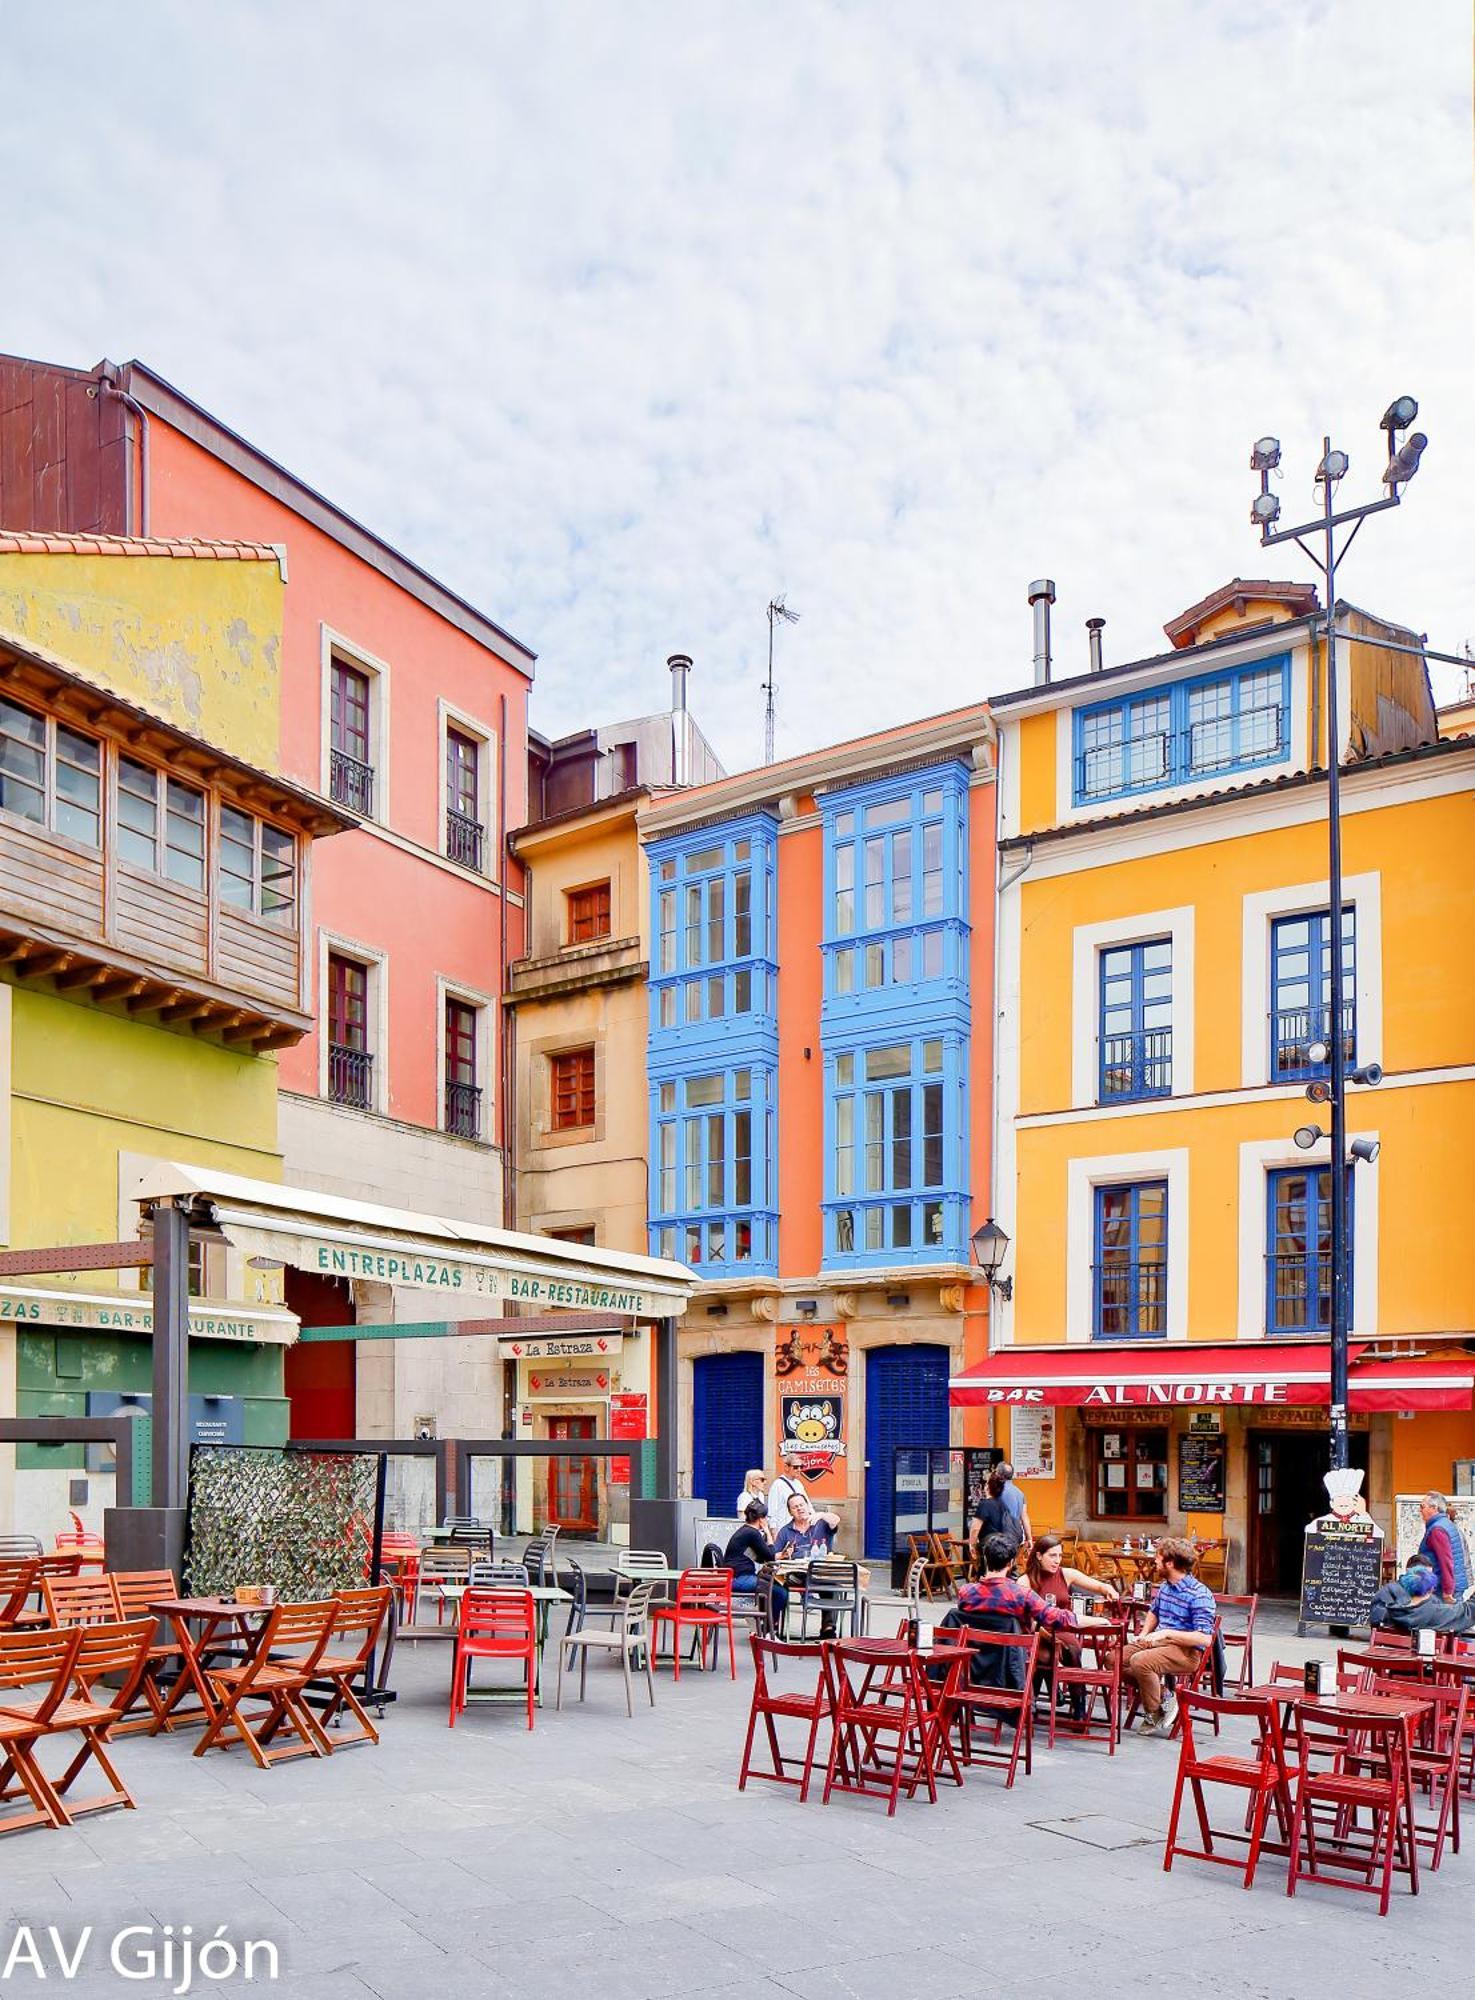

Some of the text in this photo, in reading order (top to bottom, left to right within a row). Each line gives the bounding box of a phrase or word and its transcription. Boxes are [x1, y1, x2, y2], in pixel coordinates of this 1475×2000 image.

[317, 1246, 643, 1312] ENTREPLAZAS BAR-RESTAURANTE
[525, 1343, 540, 1357] La
[546, 1342, 594, 1356] Estraza
[557, 1377, 592, 1388] Estraza
[986, 1382, 1288, 1404] BAR AL NORTE
[1321, 1521, 1373, 1532] AL NORTE
